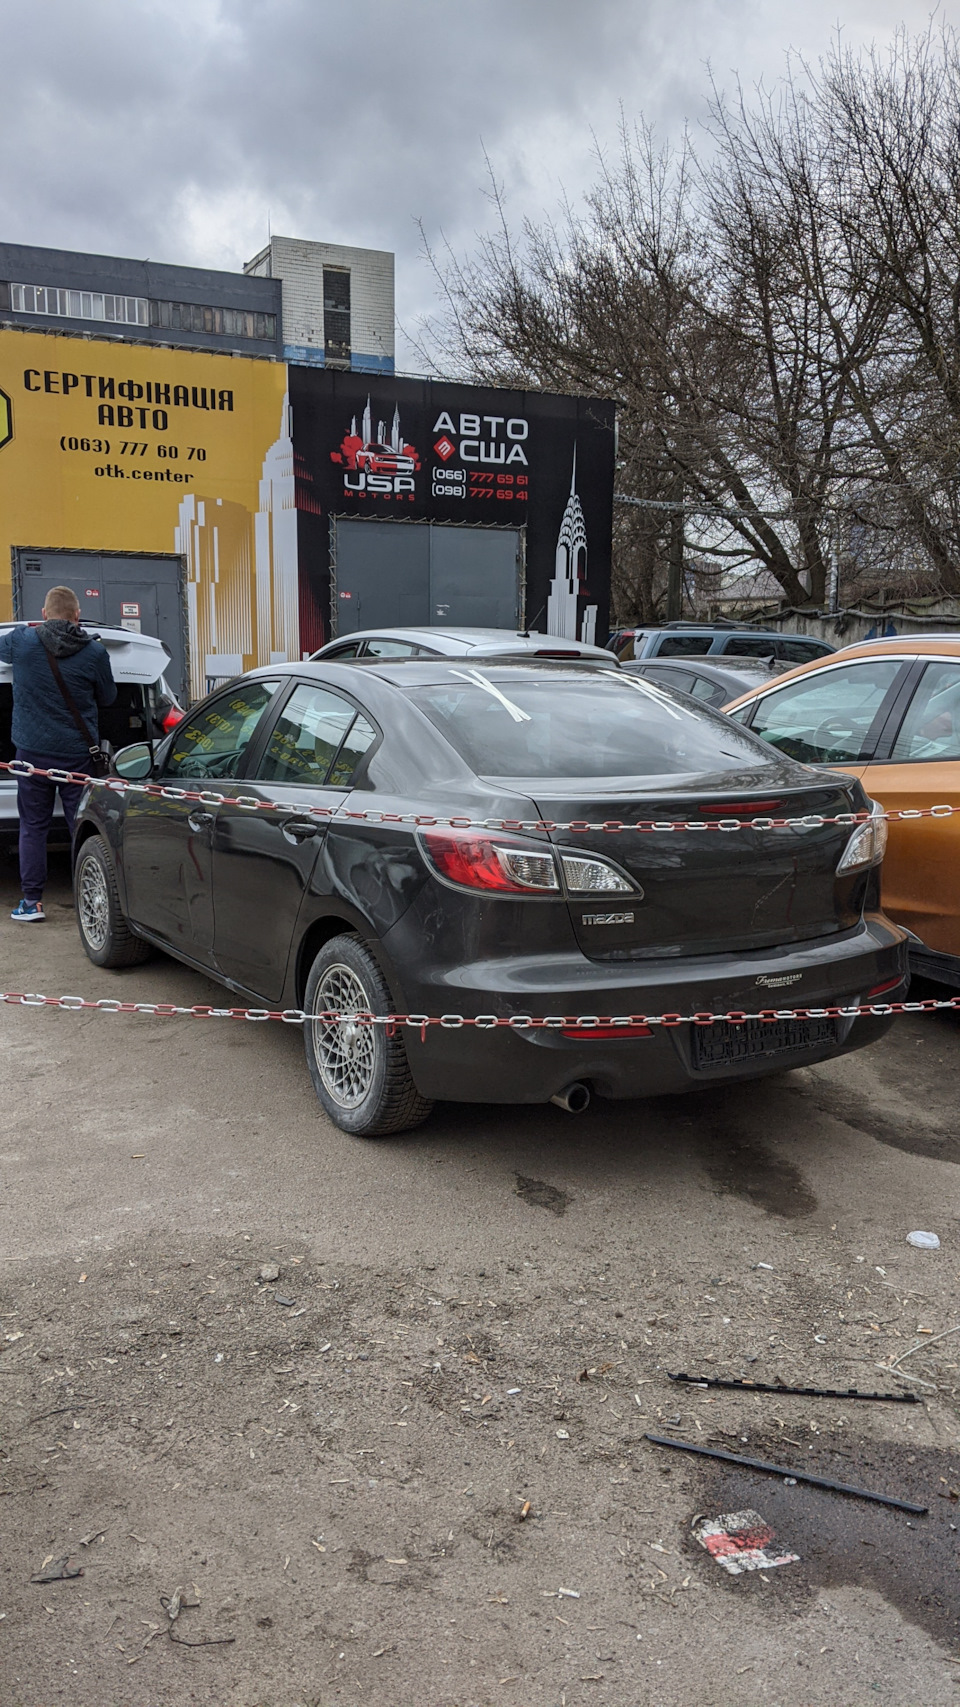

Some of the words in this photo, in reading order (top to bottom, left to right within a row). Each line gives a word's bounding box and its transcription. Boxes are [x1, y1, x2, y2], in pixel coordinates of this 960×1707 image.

[23, 368, 235, 412] СЕРТИФІКАЦІЯ
[97, 403, 169, 431] АВТО
[432, 411, 529, 440] АВТО
[60, 436, 111, 455] (063)
[119, 441, 149, 456] 777
[157, 445, 178, 459] 60
[187, 447, 207, 461] 70
[459, 439, 529, 466] США
[94, 464, 194, 483] otk.center
[344, 472, 415, 493] USA
[432, 466, 467, 483] (066)
[469, 471, 494, 483] 777
[496, 474, 514, 485] 69
[516, 475, 528, 486] 61
[343, 489, 415, 501] MOTORS
[431, 482, 466, 499] (098)
[469, 487, 494, 498] 777
[496, 489, 514, 500] 69
[515, 490, 528, 501] 41
